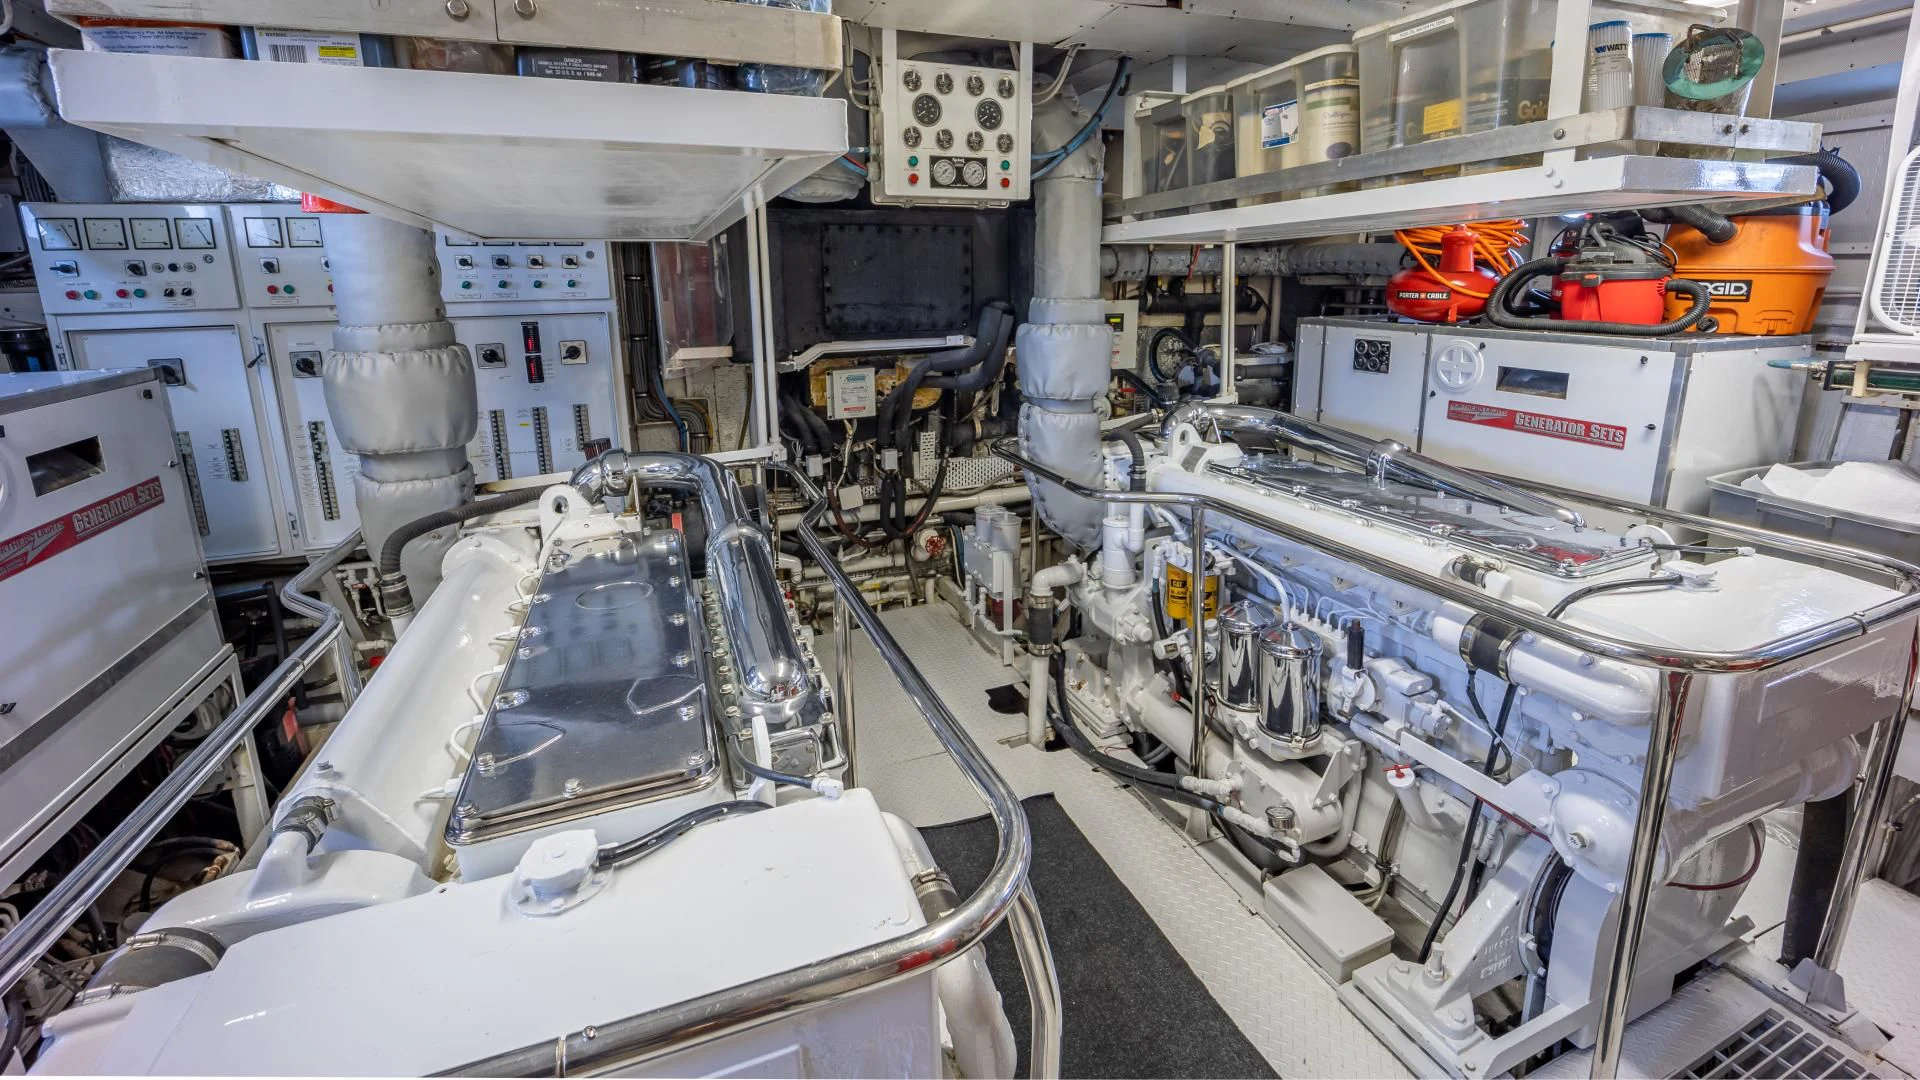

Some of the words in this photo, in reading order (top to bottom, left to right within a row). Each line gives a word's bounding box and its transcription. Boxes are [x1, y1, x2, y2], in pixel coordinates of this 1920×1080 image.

[1515, 412, 1584, 437] GENERATOR
[1590, 424, 1624, 442] SETS
[72, 493, 137, 533] GENERATOR
[137, 481, 162, 503] SETS
